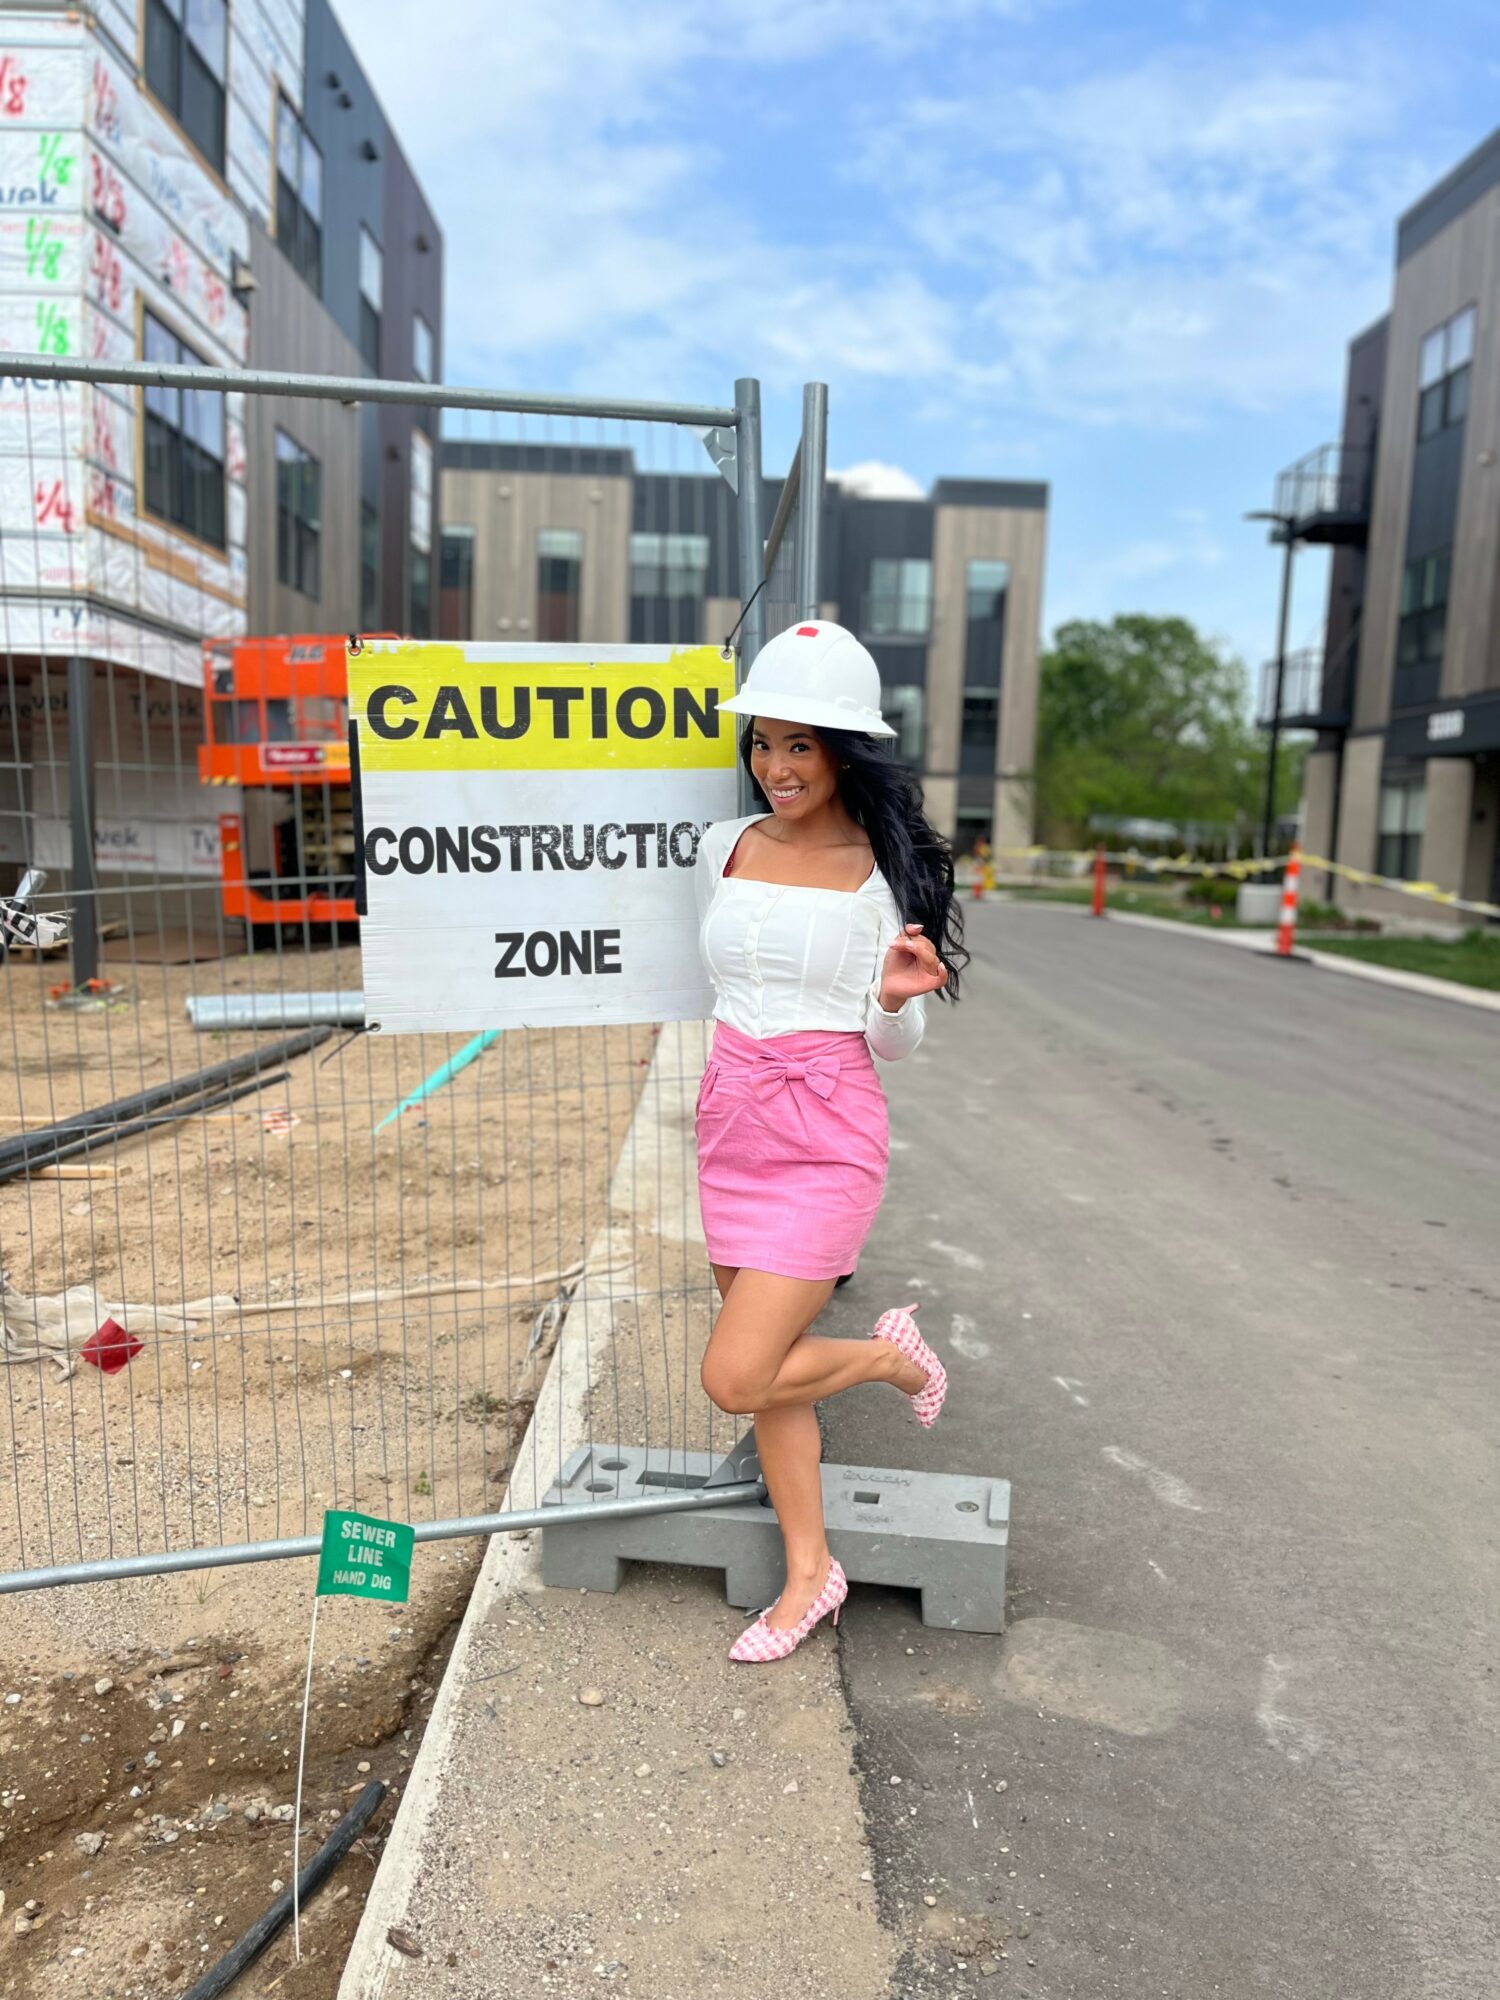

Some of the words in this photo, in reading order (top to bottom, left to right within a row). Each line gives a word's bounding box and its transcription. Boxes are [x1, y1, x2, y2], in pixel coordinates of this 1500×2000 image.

[366, 684, 720, 740] CAUTION
[364, 821, 714, 876] CONSTRUCTIO
[494, 929, 622, 978] ZONE
[340, 1520, 397, 1548] SEWER
[347, 1544, 384, 1567] LINE
[332, 1570, 366, 1586] HAND
[370, 1573, 392, 1590] DIG
